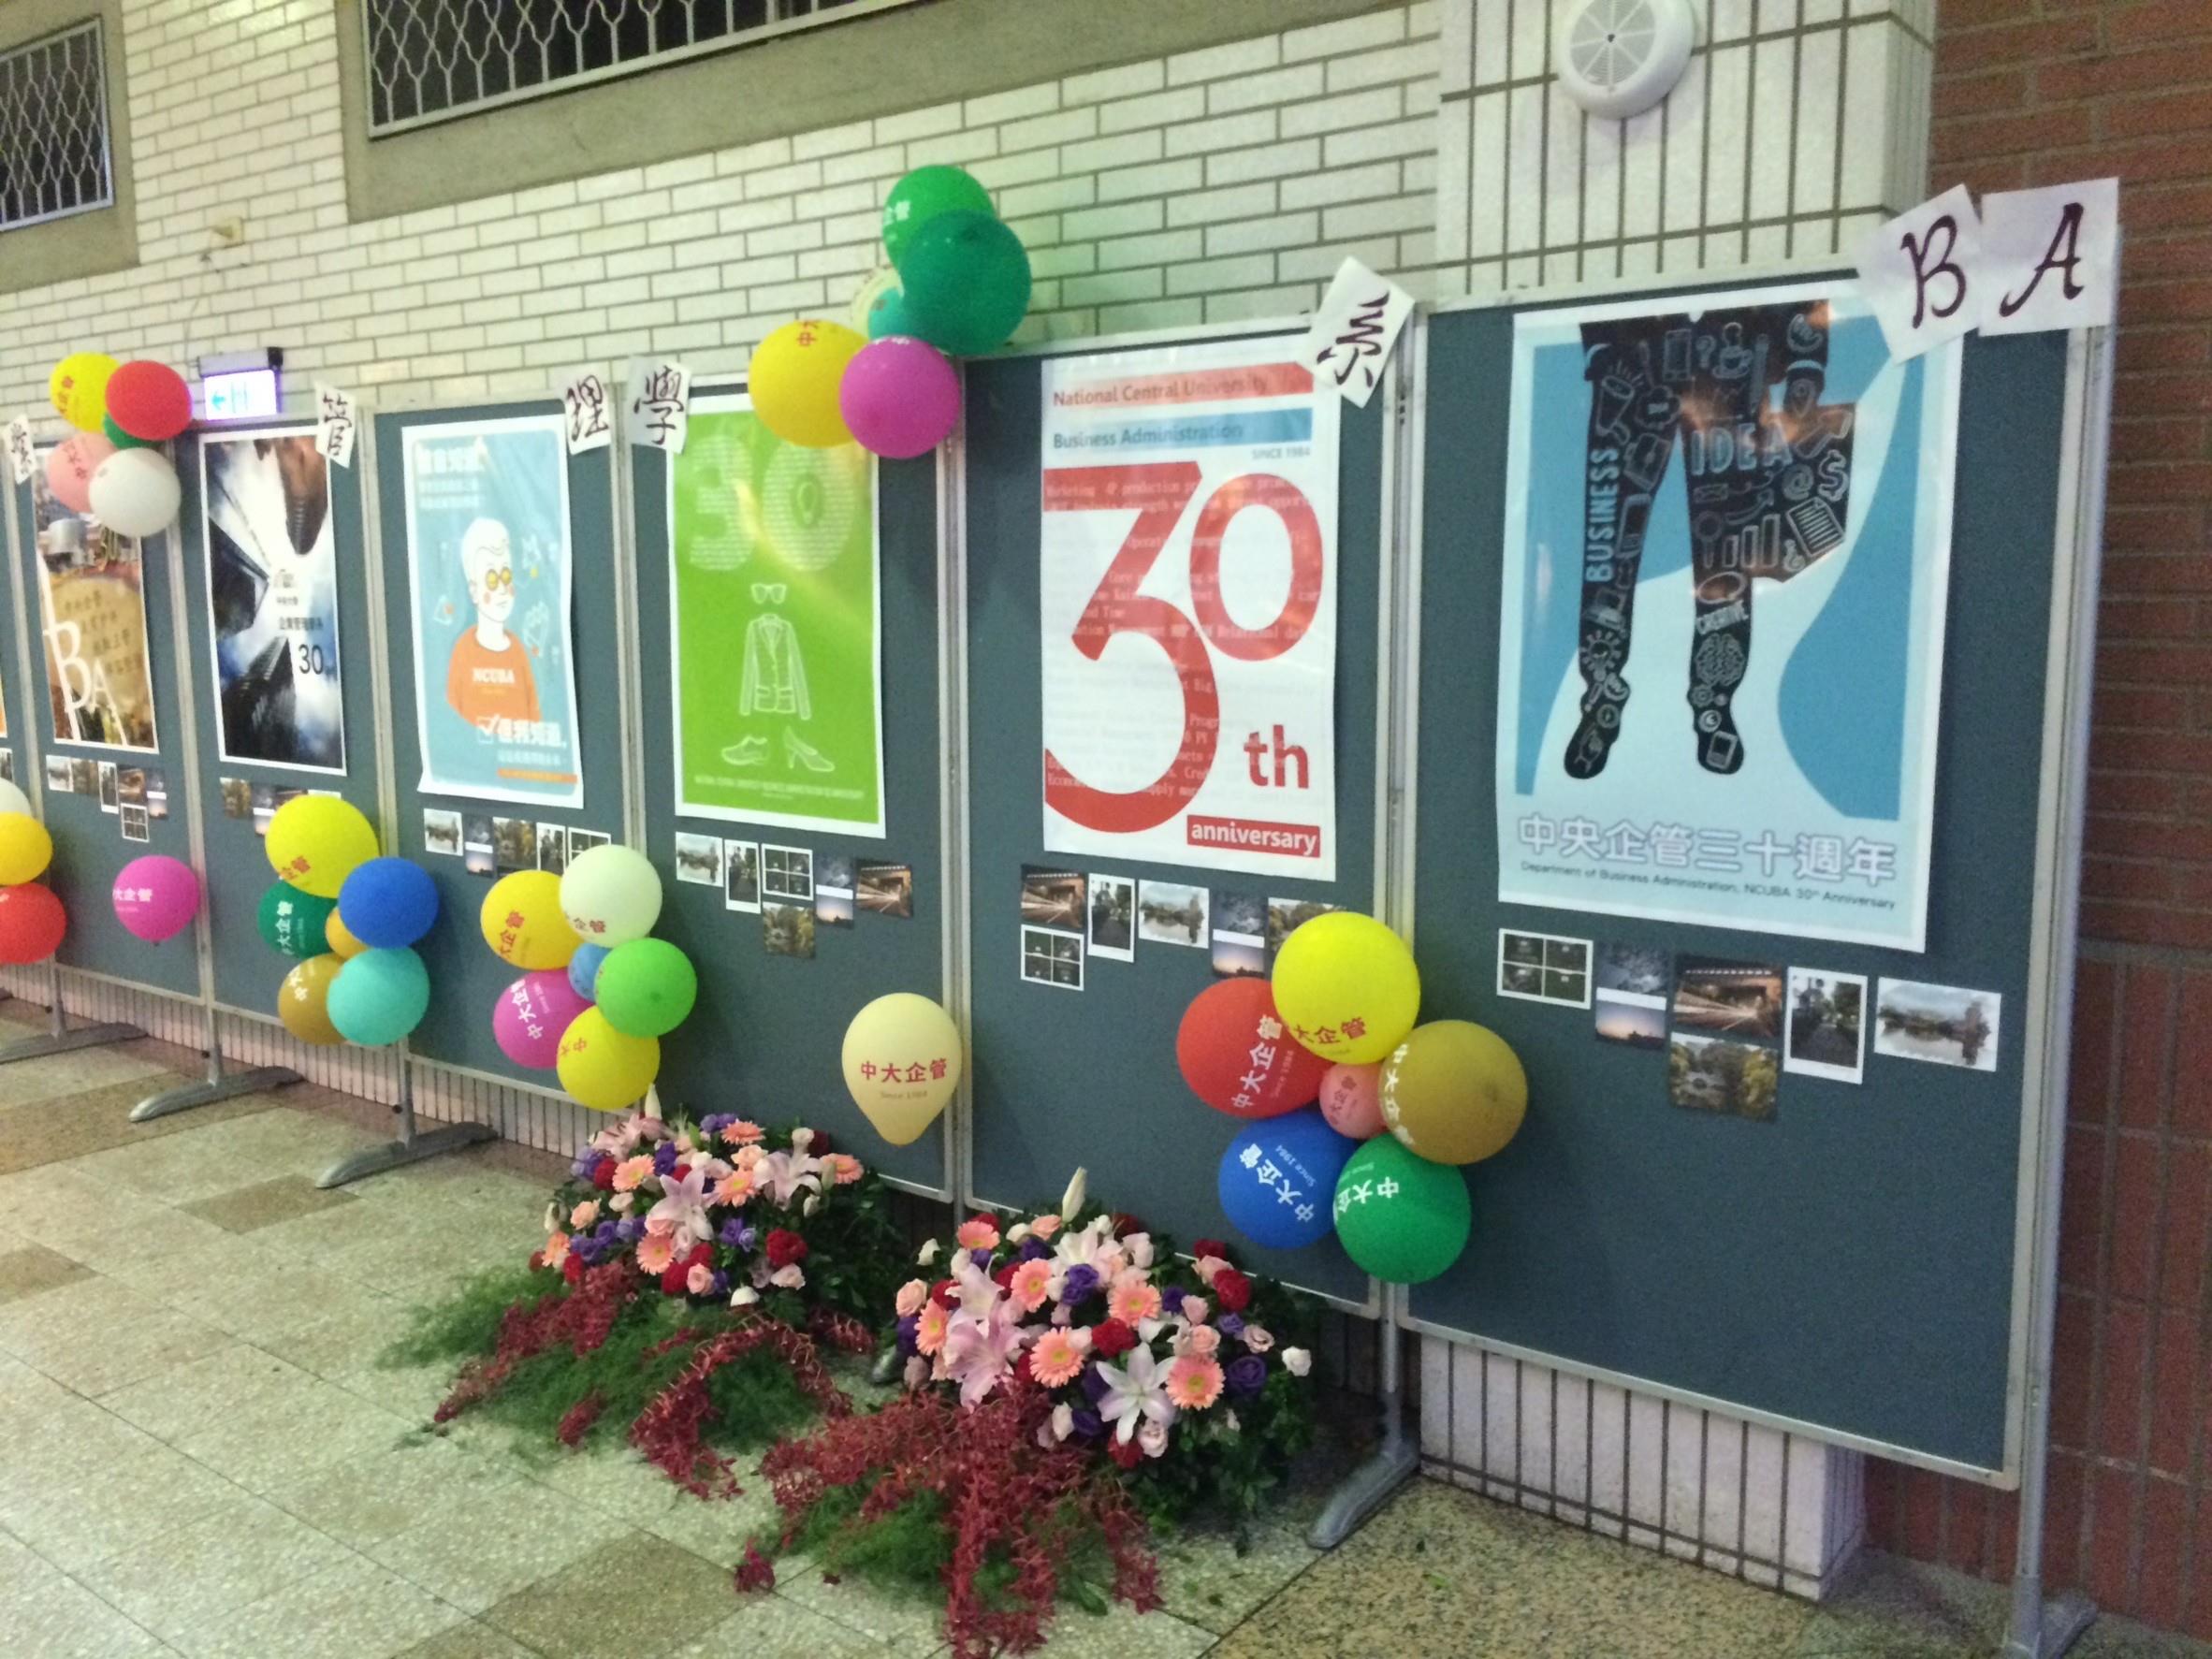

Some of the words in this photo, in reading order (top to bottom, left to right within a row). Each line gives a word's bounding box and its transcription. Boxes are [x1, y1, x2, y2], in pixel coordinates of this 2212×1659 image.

[1900, 215, 1967, 328] B
[1999, 202, 2085, 317] A
[1317, 291, 1390, 388] 系
[322, 392, 353, 457] 管
[565, 374, 609, 442] 理
[633, 365, 684, 445] 學
[1053, 385, 1118, 407] National
[1123, 380, 1179, 402] Central
[1053, 431, 1116, 449] Business
[1690, 420, 1793, 476] IDEA
[1586, 448, 1619, 582] BUSINESS
[298, 643, 324, 675] 30
[1043, 460, 1324, 833] 30
[1244, 724, 1310, 789] th
[1191, 821, 1318, 857] anniversary
[1519, 811, 1897, 887] 中央企管三十週年
[1521, 861, 1581, 877] Department
[1584, 868, 1597, 879] of
[1598, 869, 1649, 883] Business
[1743, 882, 1791, 897] NCUBA
[1823, 891, 1896, 910] Anniversary
[860, 1057, 947, 1084] 中大企管
[1230, 1013, 1283, 1109] 中大企管
[1239, 1142, 1315, 1223] 中大企管
[1335, 1175, 1400, 1221] 中大企
